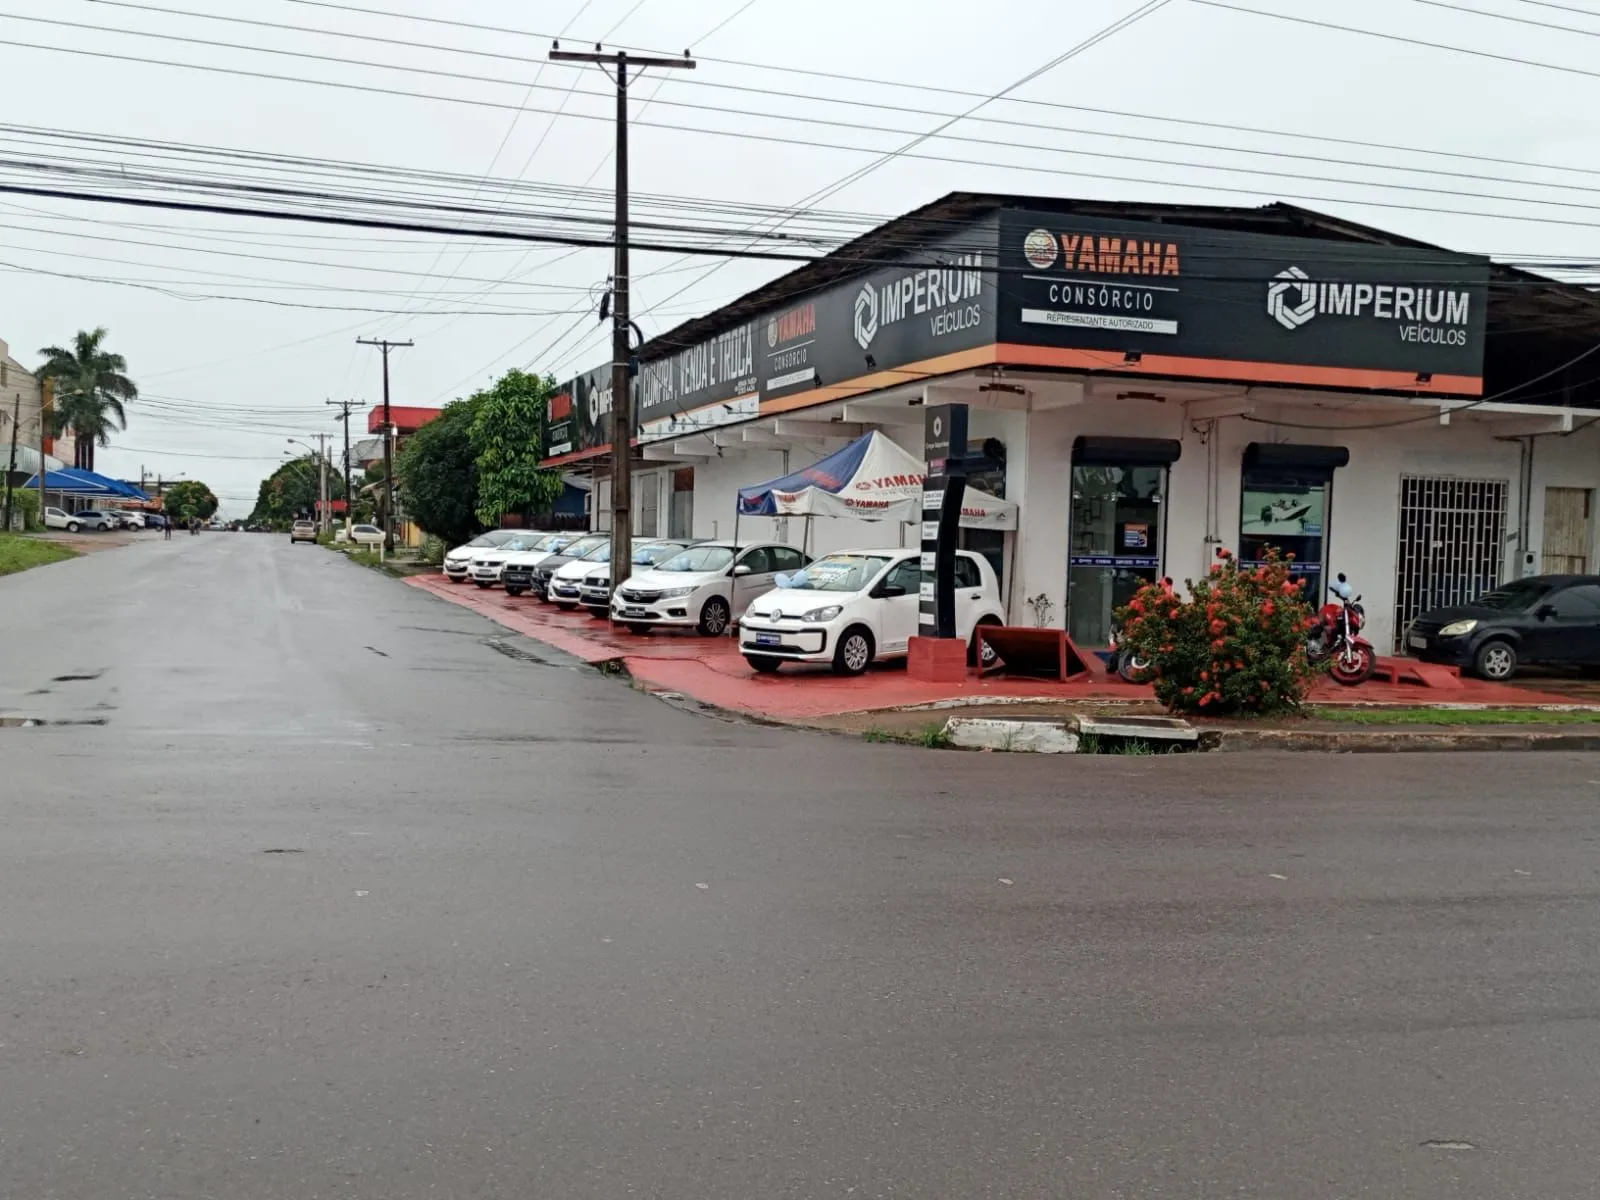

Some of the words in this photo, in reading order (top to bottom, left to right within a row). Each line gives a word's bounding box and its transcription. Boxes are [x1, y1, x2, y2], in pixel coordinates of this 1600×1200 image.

[1060, 233, 1180, 276] YAMAHA
[881, 250, 982, 326] IMPERIUM
[1050, 284, 1153, 310] CONSÓRCIO
[1319, 282, 1470, 325] IMPERIUM
[930, 304, 981, 337] VEÍCULOS
[1109, 318, 1154, 330] AUTORIZADO
[1399, 323, 1467, 346] VEÍCULOS
[680, 341, 708, 396] VENDA
[710, 336, 716, 386] E
[718, 324, 753, 384] TROCA
[872, 474, 929, 489] YAMAH
[960, 507, 986, 517] MAHA
